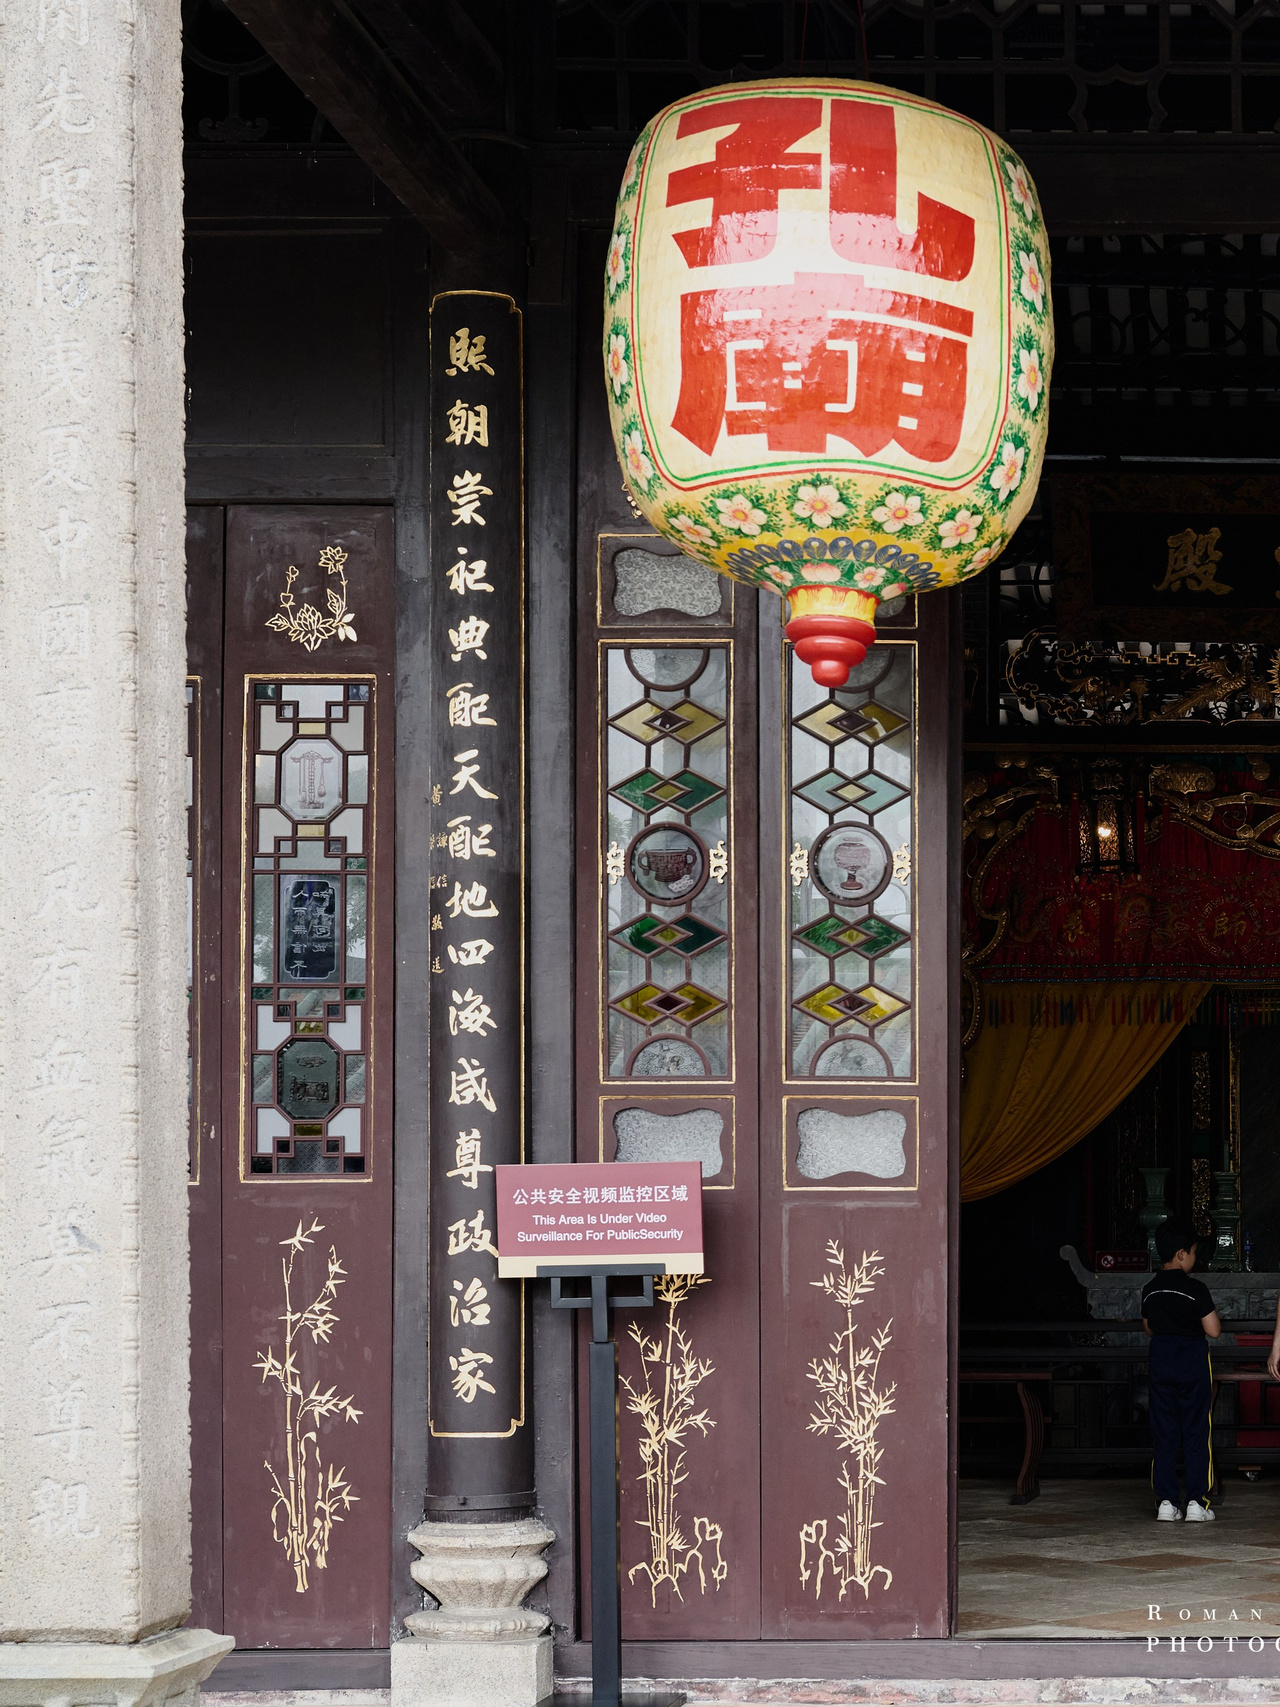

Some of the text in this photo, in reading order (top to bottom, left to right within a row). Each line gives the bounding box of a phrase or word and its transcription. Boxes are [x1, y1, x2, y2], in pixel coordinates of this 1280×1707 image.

[512, 1185, 689, 1206] 公共安全视频监控区域
[532, 1212, 667, 1226] This Area Is Under Video
[517, 1230, 583, 1242] Surveillance
[586, 1229, 604, 1240] For
